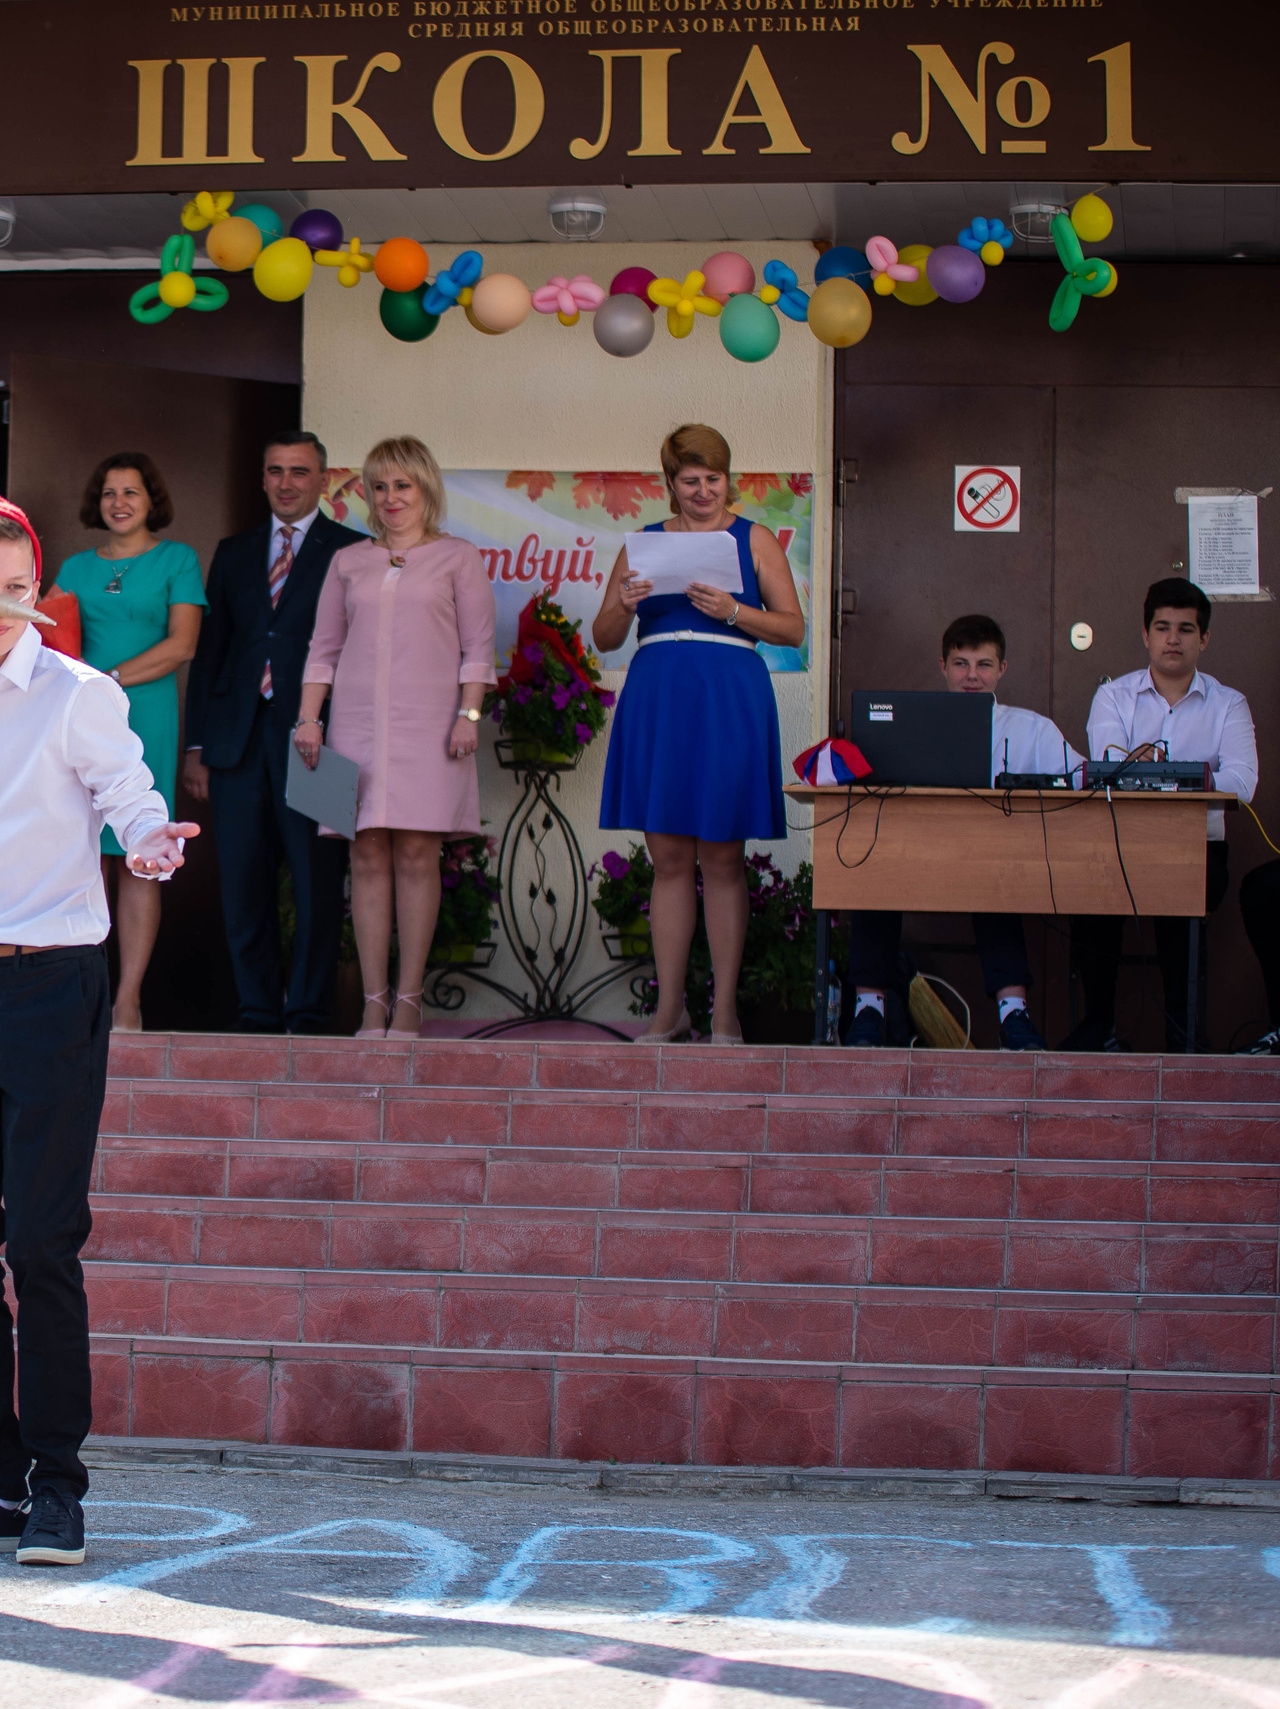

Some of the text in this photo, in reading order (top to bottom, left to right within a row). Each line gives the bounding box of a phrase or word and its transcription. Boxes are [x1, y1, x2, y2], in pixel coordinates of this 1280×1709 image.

[171, 2, 401, 22] МУНИЦИПАЛЬНОЕ
[413, 0, 577, 17] БЮДЖЕТНОЕ
[591, 0, 915, 14] ОБЩЕОБРАЗОВАТЕЛЬНОЕ
[408, 16, 860, 39] СРЕДНЯЯ ОБЩЕОБРАЗОВАТЕЛЬНАЯ
[125, 44, 812, 167] ШКОЛА
[480, 533, 604, 597] твуй,
[869, 702, 893, 711] Lenovo
